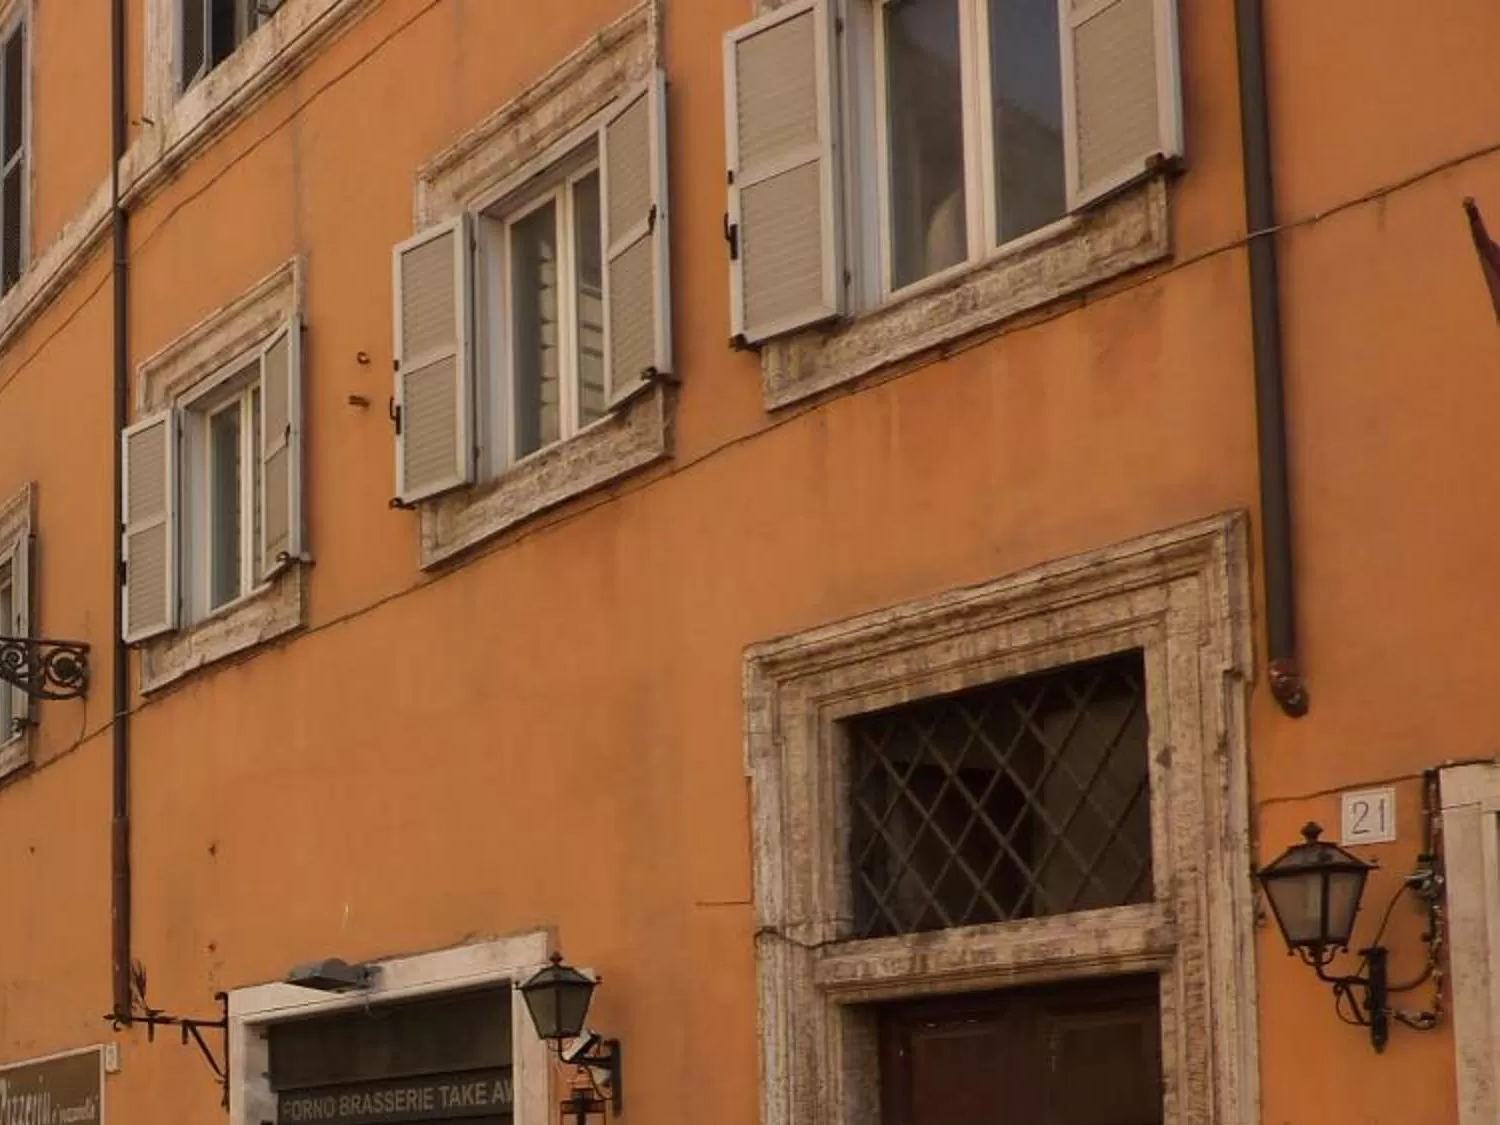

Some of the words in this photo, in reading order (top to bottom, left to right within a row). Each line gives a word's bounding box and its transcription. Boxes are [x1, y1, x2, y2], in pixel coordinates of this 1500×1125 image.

[1351, 798, 1386, 835] 21
[283, 1096, 336, 1122] FORNO
[338, 1087, 435, 1117] BRASSERIE
[438, 1081, 487, 1109] TAKE
